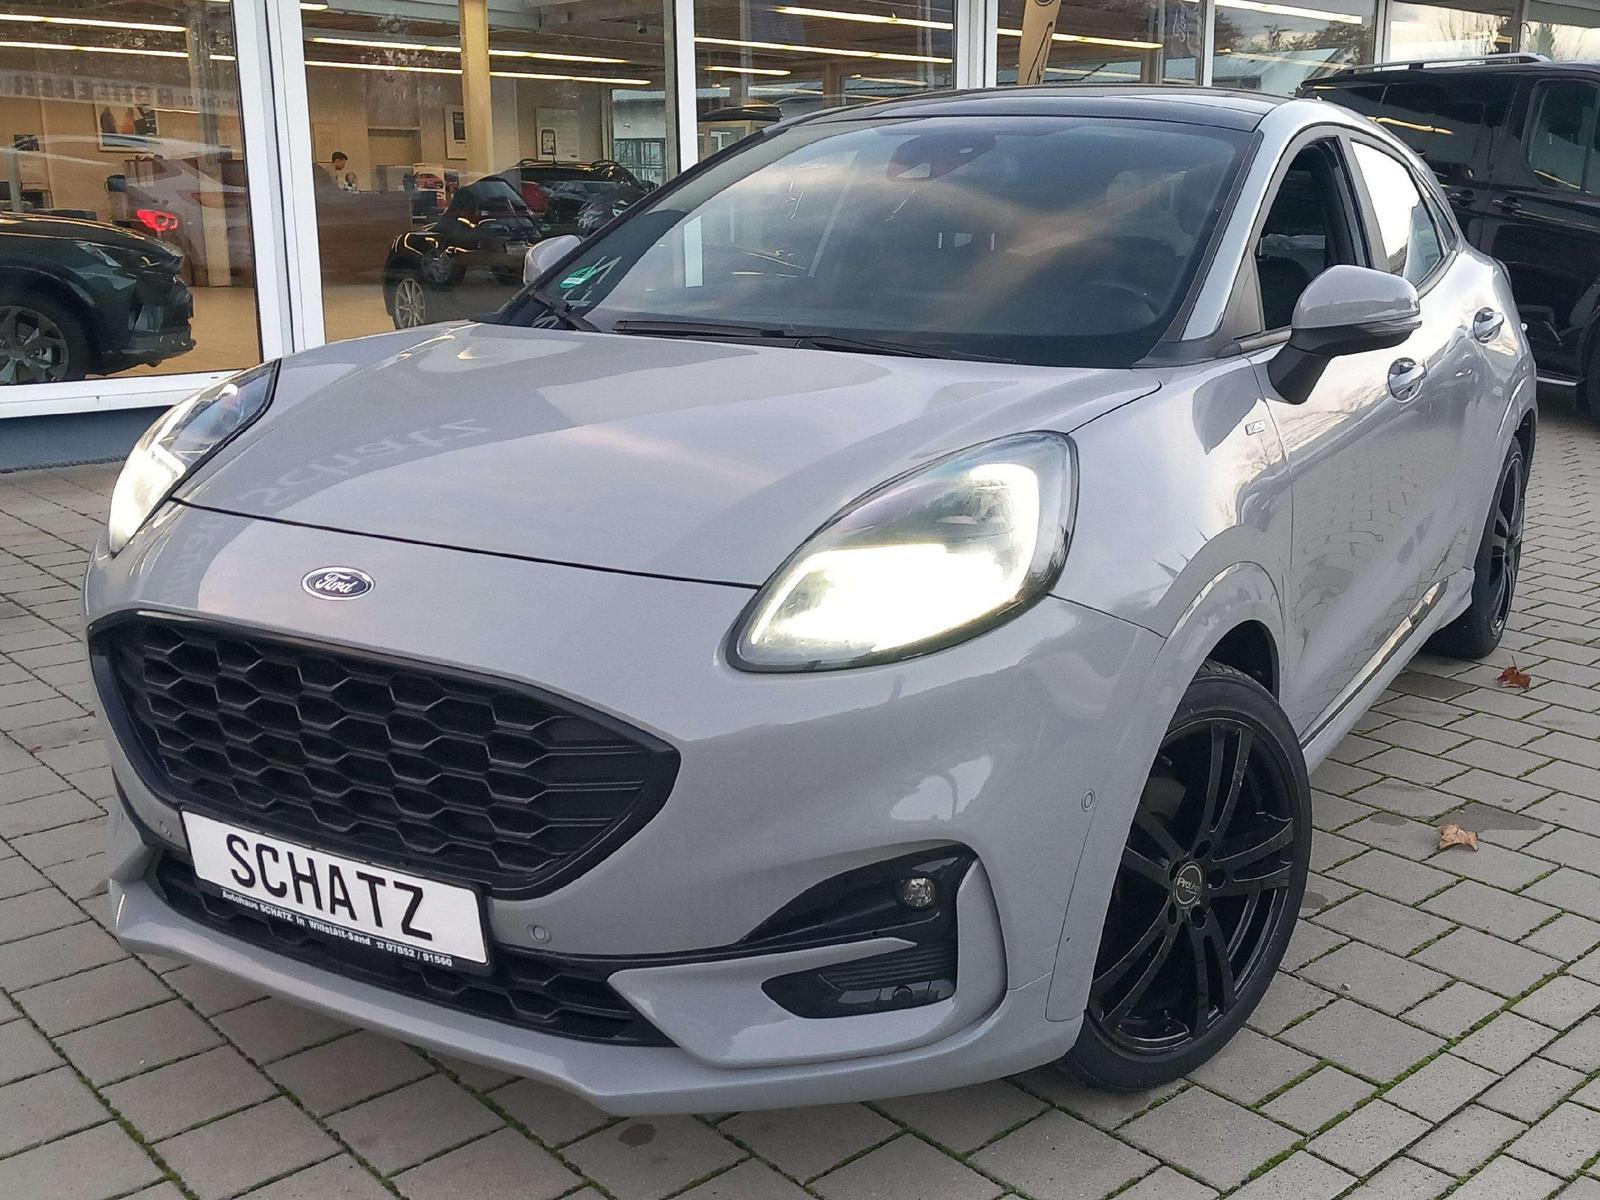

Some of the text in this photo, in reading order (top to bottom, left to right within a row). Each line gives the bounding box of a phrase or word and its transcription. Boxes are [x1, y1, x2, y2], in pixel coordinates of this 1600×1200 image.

[315, 572, 359, 594] Ford
[225, 833, 433, 942] SCHATZ
[222, 889, 259, 910] Autohaus
[259, 903, 293, 922] SCHATZ
[296, 915, 305, 926] in
